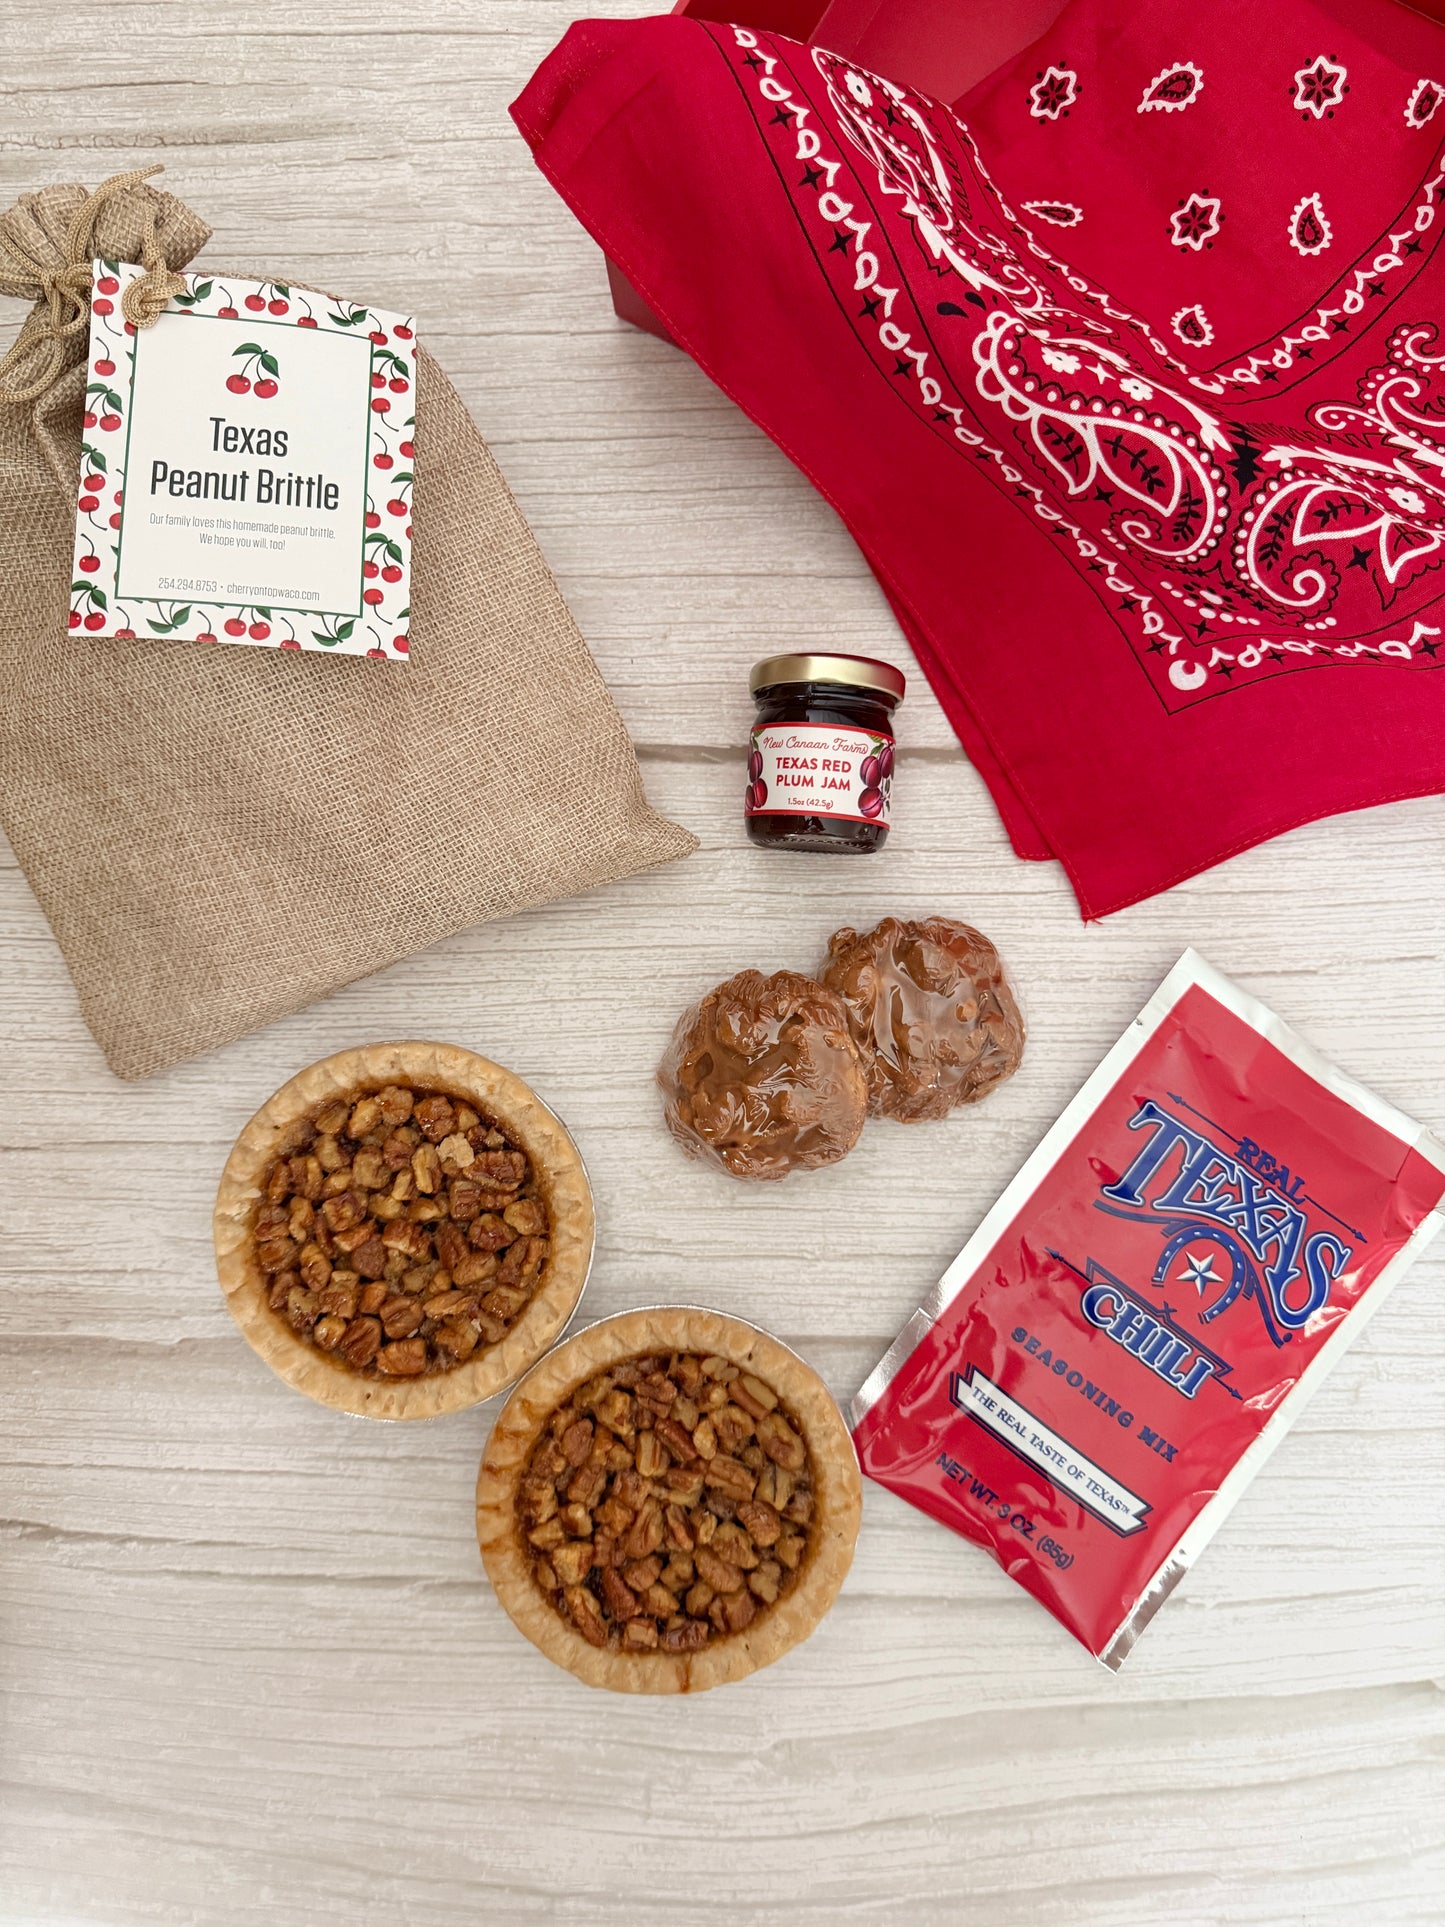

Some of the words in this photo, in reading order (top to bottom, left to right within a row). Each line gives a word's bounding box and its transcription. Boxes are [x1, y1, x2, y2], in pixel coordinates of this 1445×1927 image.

[209, 417, 289, 458] Texas
[150, 460, 250, 502] Peanut
[256, 468, 340, 511] Brittle
[149, 512, 164, 525] Our
[165, 513, 191, 528] family
[192, 515, 215, 529] loves
[216, 517, 232, 530] this
[232, 519, 279, 534] homemade
[280, 524, 309, 535] peanut
[199, 532, 213, 545] We
[213, 533, 235, 548] hope
[235, 536, 252, 549] you
[269, 539, 287, 551] too!
[158, 577, 218, 593] 254.294.8753
[226, 582, 321, 601] cherryontopwaco.com
[763, 736, 784, 750] New
[785, 735, 830, 751] Canaan
[832, 737, 869, 756] Farms
[775, 757, 818, 770] TEXAS
[821, 758, 852, 774] RED
[775, 774, 815, 788] PLUM
[820, 776, 851, 792] JAM
[787, 797, 805, 807] 1.5oz
[806, 797, 834, 810] (42.5g)
[1234, 1136, 1306, 1205] REAL
[1101, 1101, 1353, 1330] TEXAS
[1081, 1284, 1215, 1399] CHILI
[1010, 1326, 1135, 1429] SEASONING
[1137, 1425, 1179, 1463] MIX
[972, 1385, 998, 1413] THE
[996, 1407, 1028, 1439] REAL
[1029, 1432, 1068, 1469] TASTE
[1066, 1463, 1087, 1482] OF
[934, 1451, 973, 1486] NET
[968, 1477, 1000, 1511] WT.
[996, 1502, 1011, 1520] 3
[1009, 1513, 1038, 1542] OZ
[1035, 1534, 1075, 1571] (85g)
